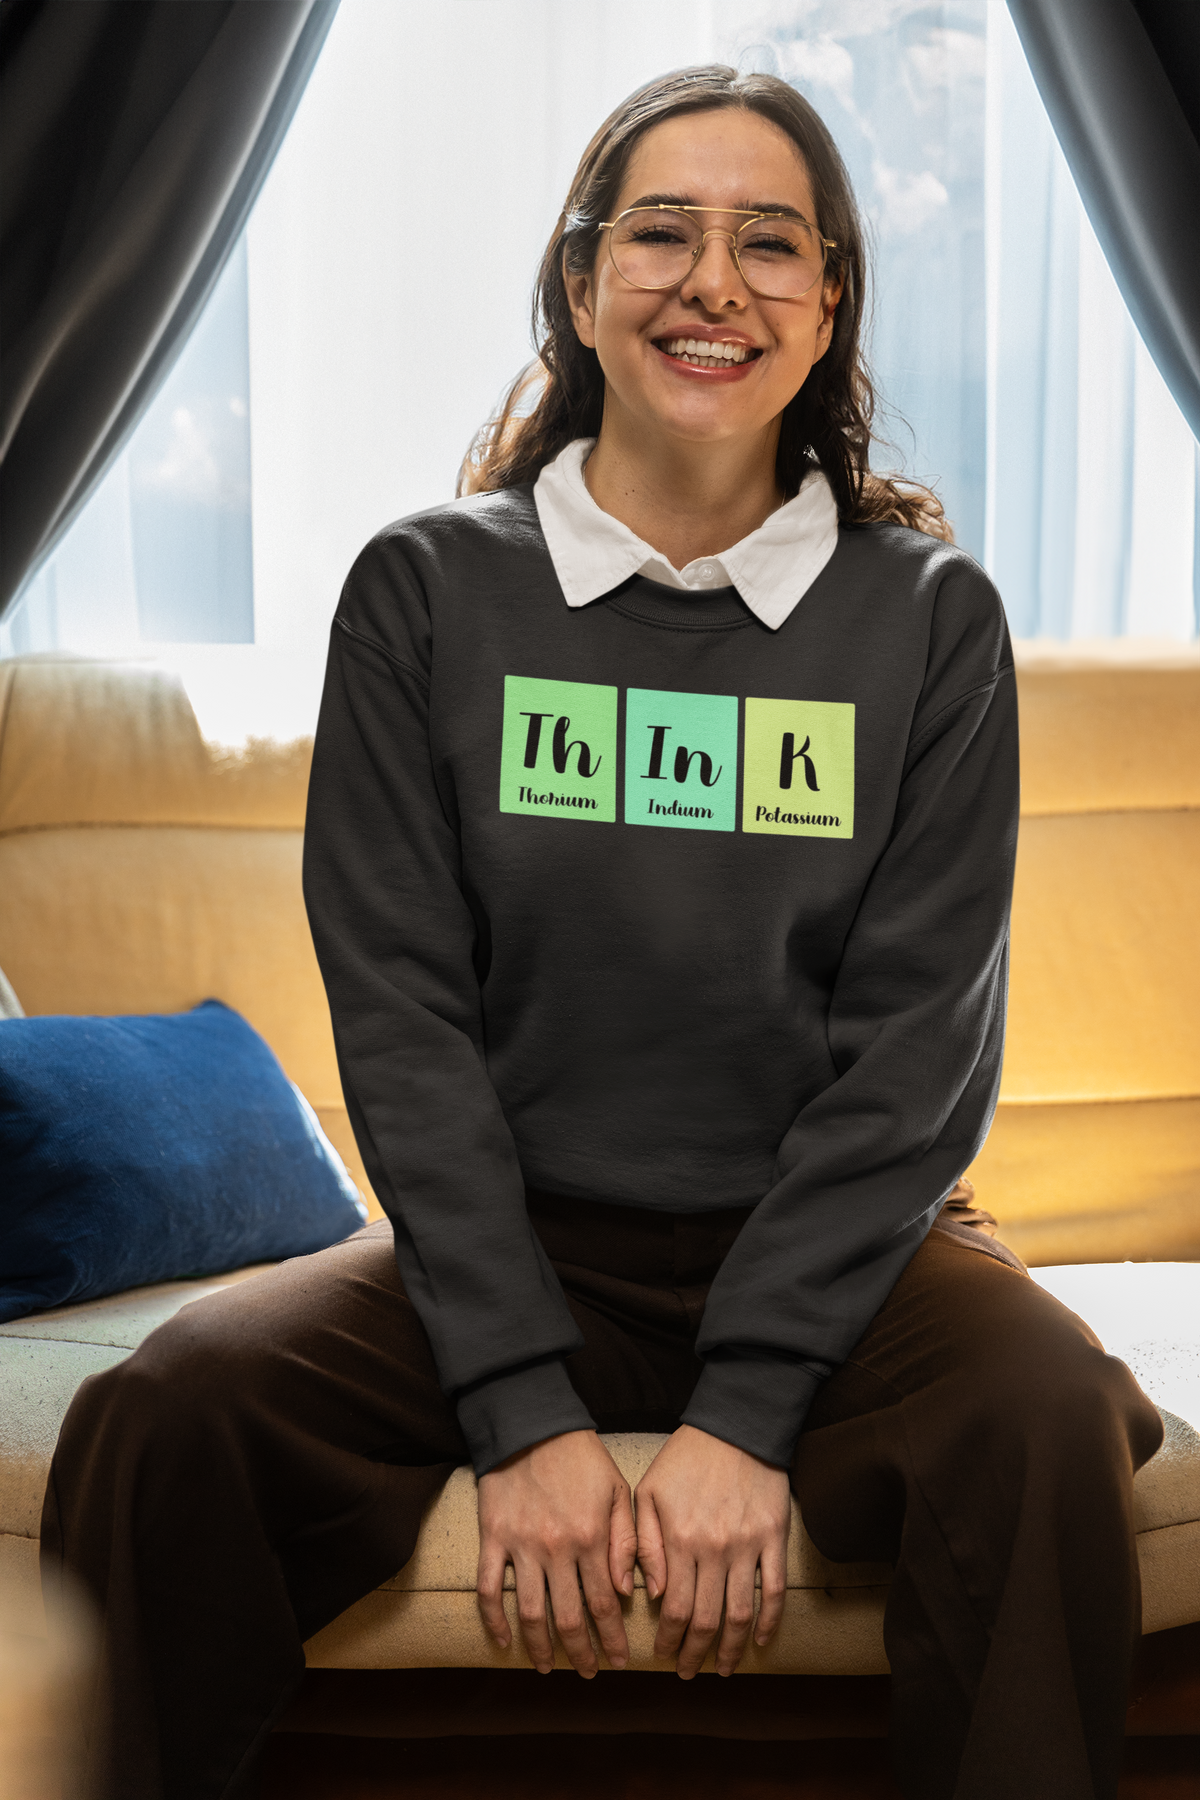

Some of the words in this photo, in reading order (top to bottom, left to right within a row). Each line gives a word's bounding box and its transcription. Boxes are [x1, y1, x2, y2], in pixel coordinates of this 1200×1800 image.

[519, 711, 603, 779] Th
[639, 725, 723, 788] In
[778, 731, 821, 793] K
[518, 786, 598, 810] Thorium
[647, 798, 715, 819] Indium
[755, 805, 842, 827] Potassium
